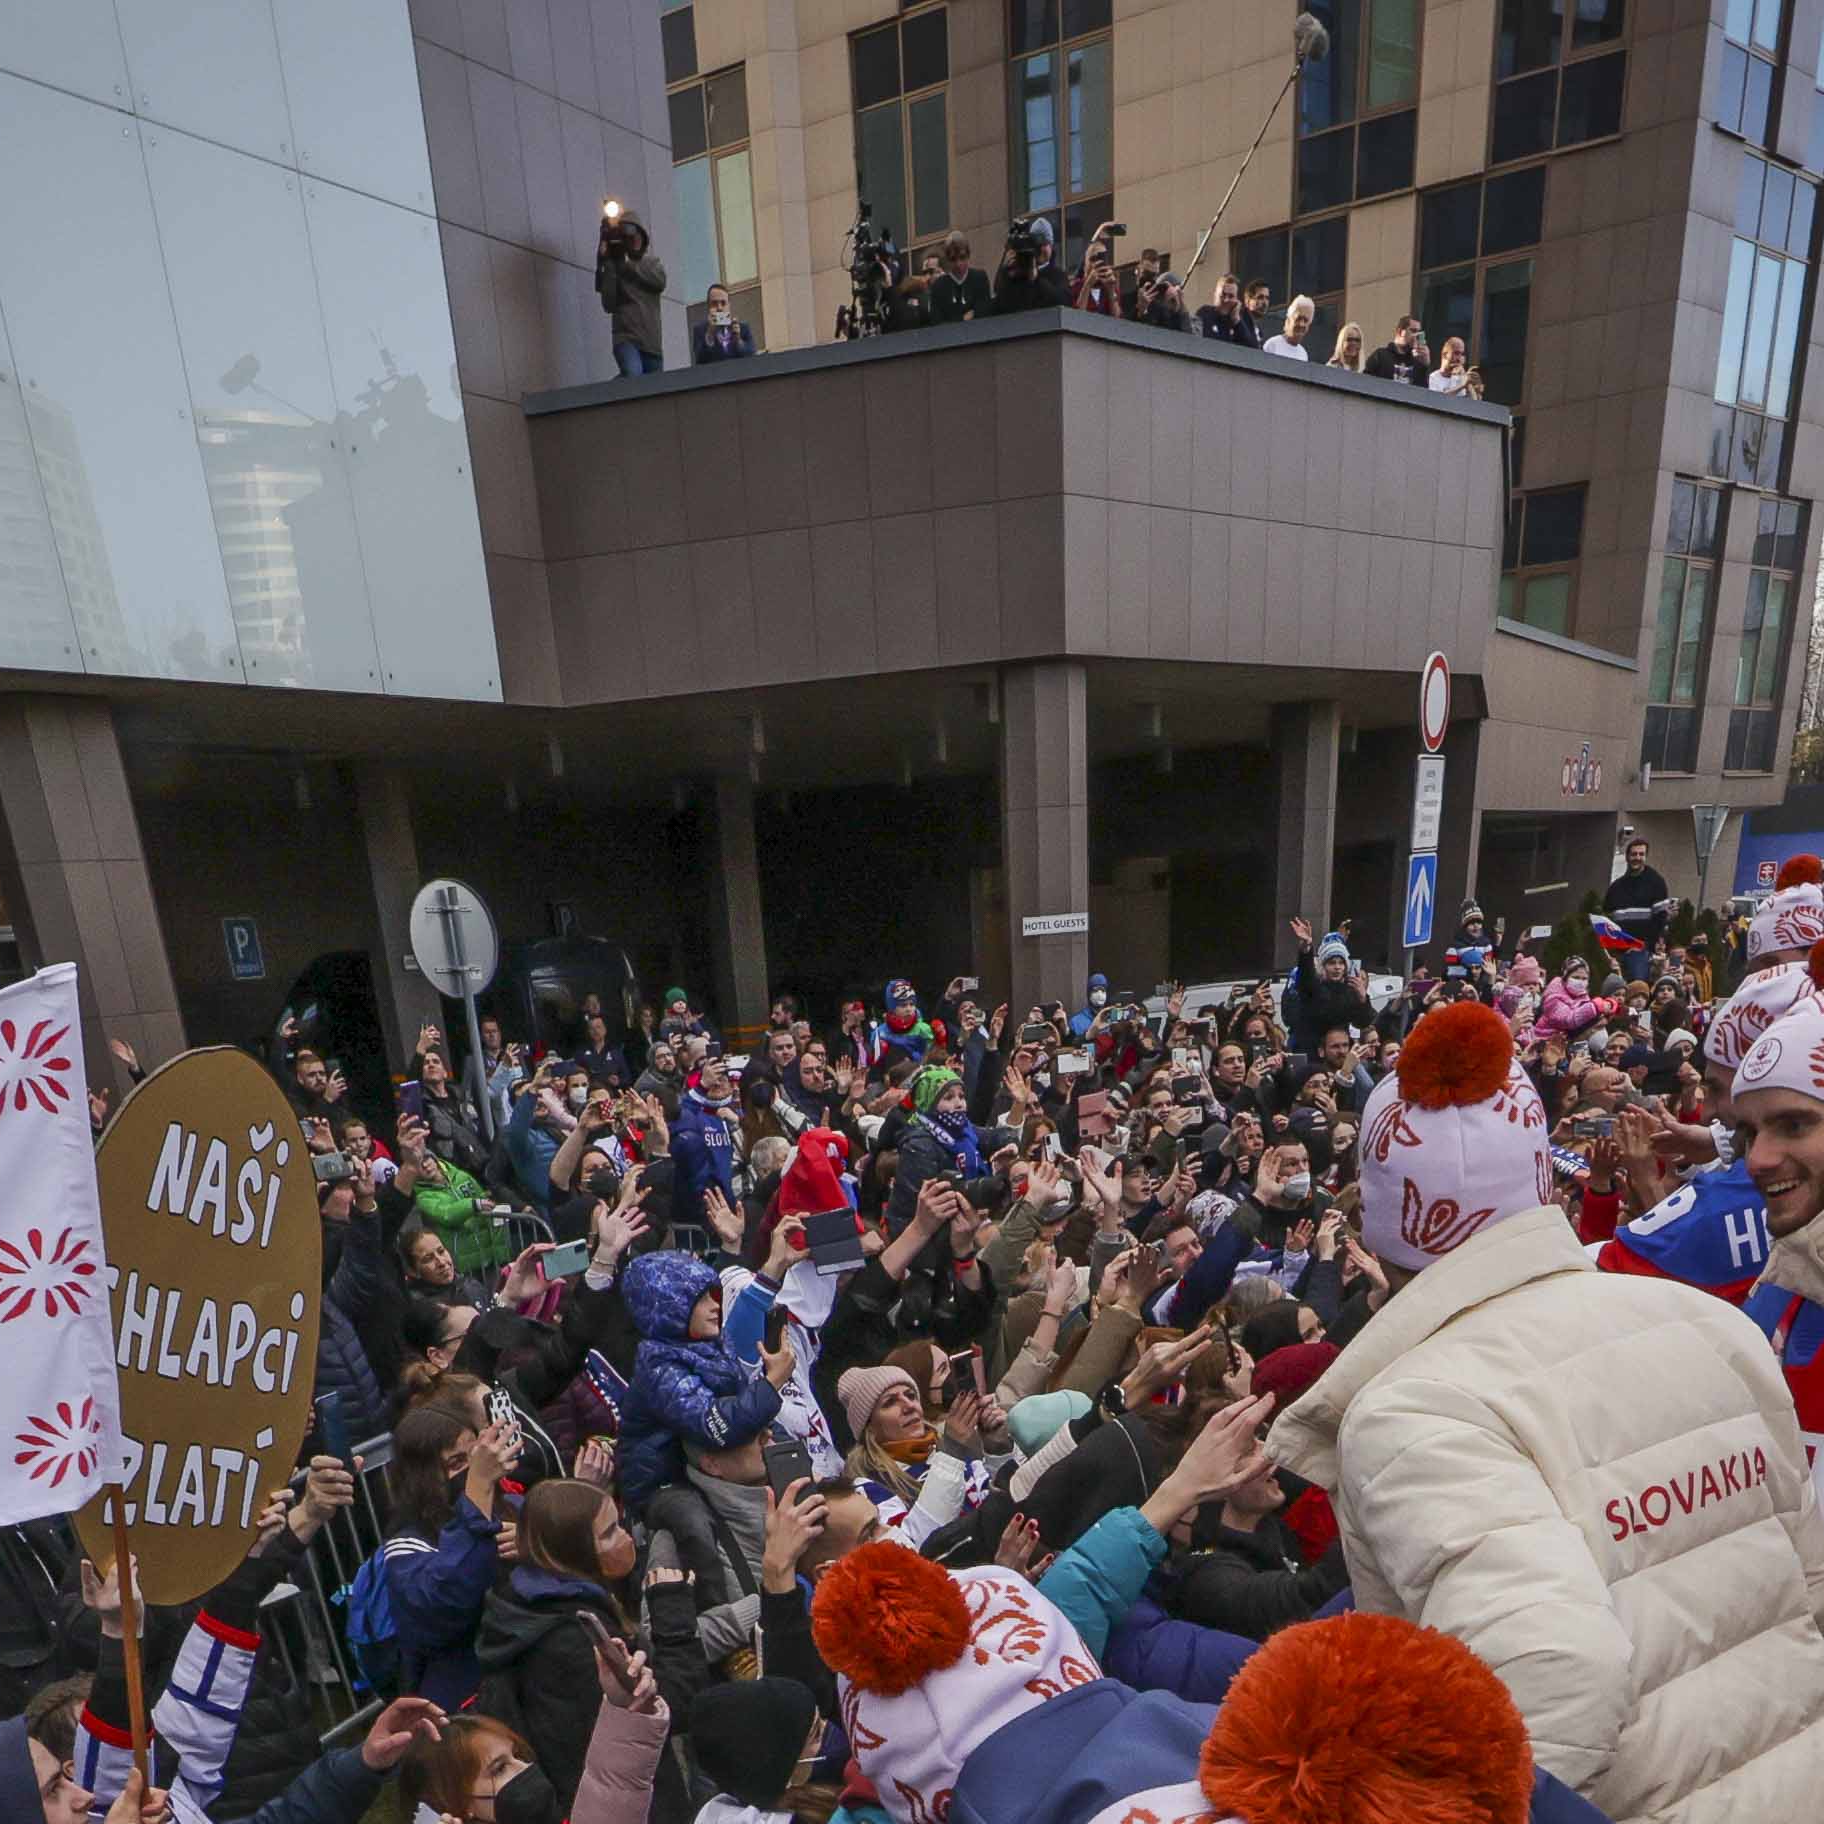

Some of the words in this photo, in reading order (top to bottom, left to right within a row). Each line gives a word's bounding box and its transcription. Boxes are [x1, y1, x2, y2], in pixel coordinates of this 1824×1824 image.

[1024, 921, 1052, 931] HOTEL
[1053, 918, 1086, 929] GUESTS
[233, 926, 249, 958] P
[1604, 1445, 1769, 1541] SLOVAKIA
